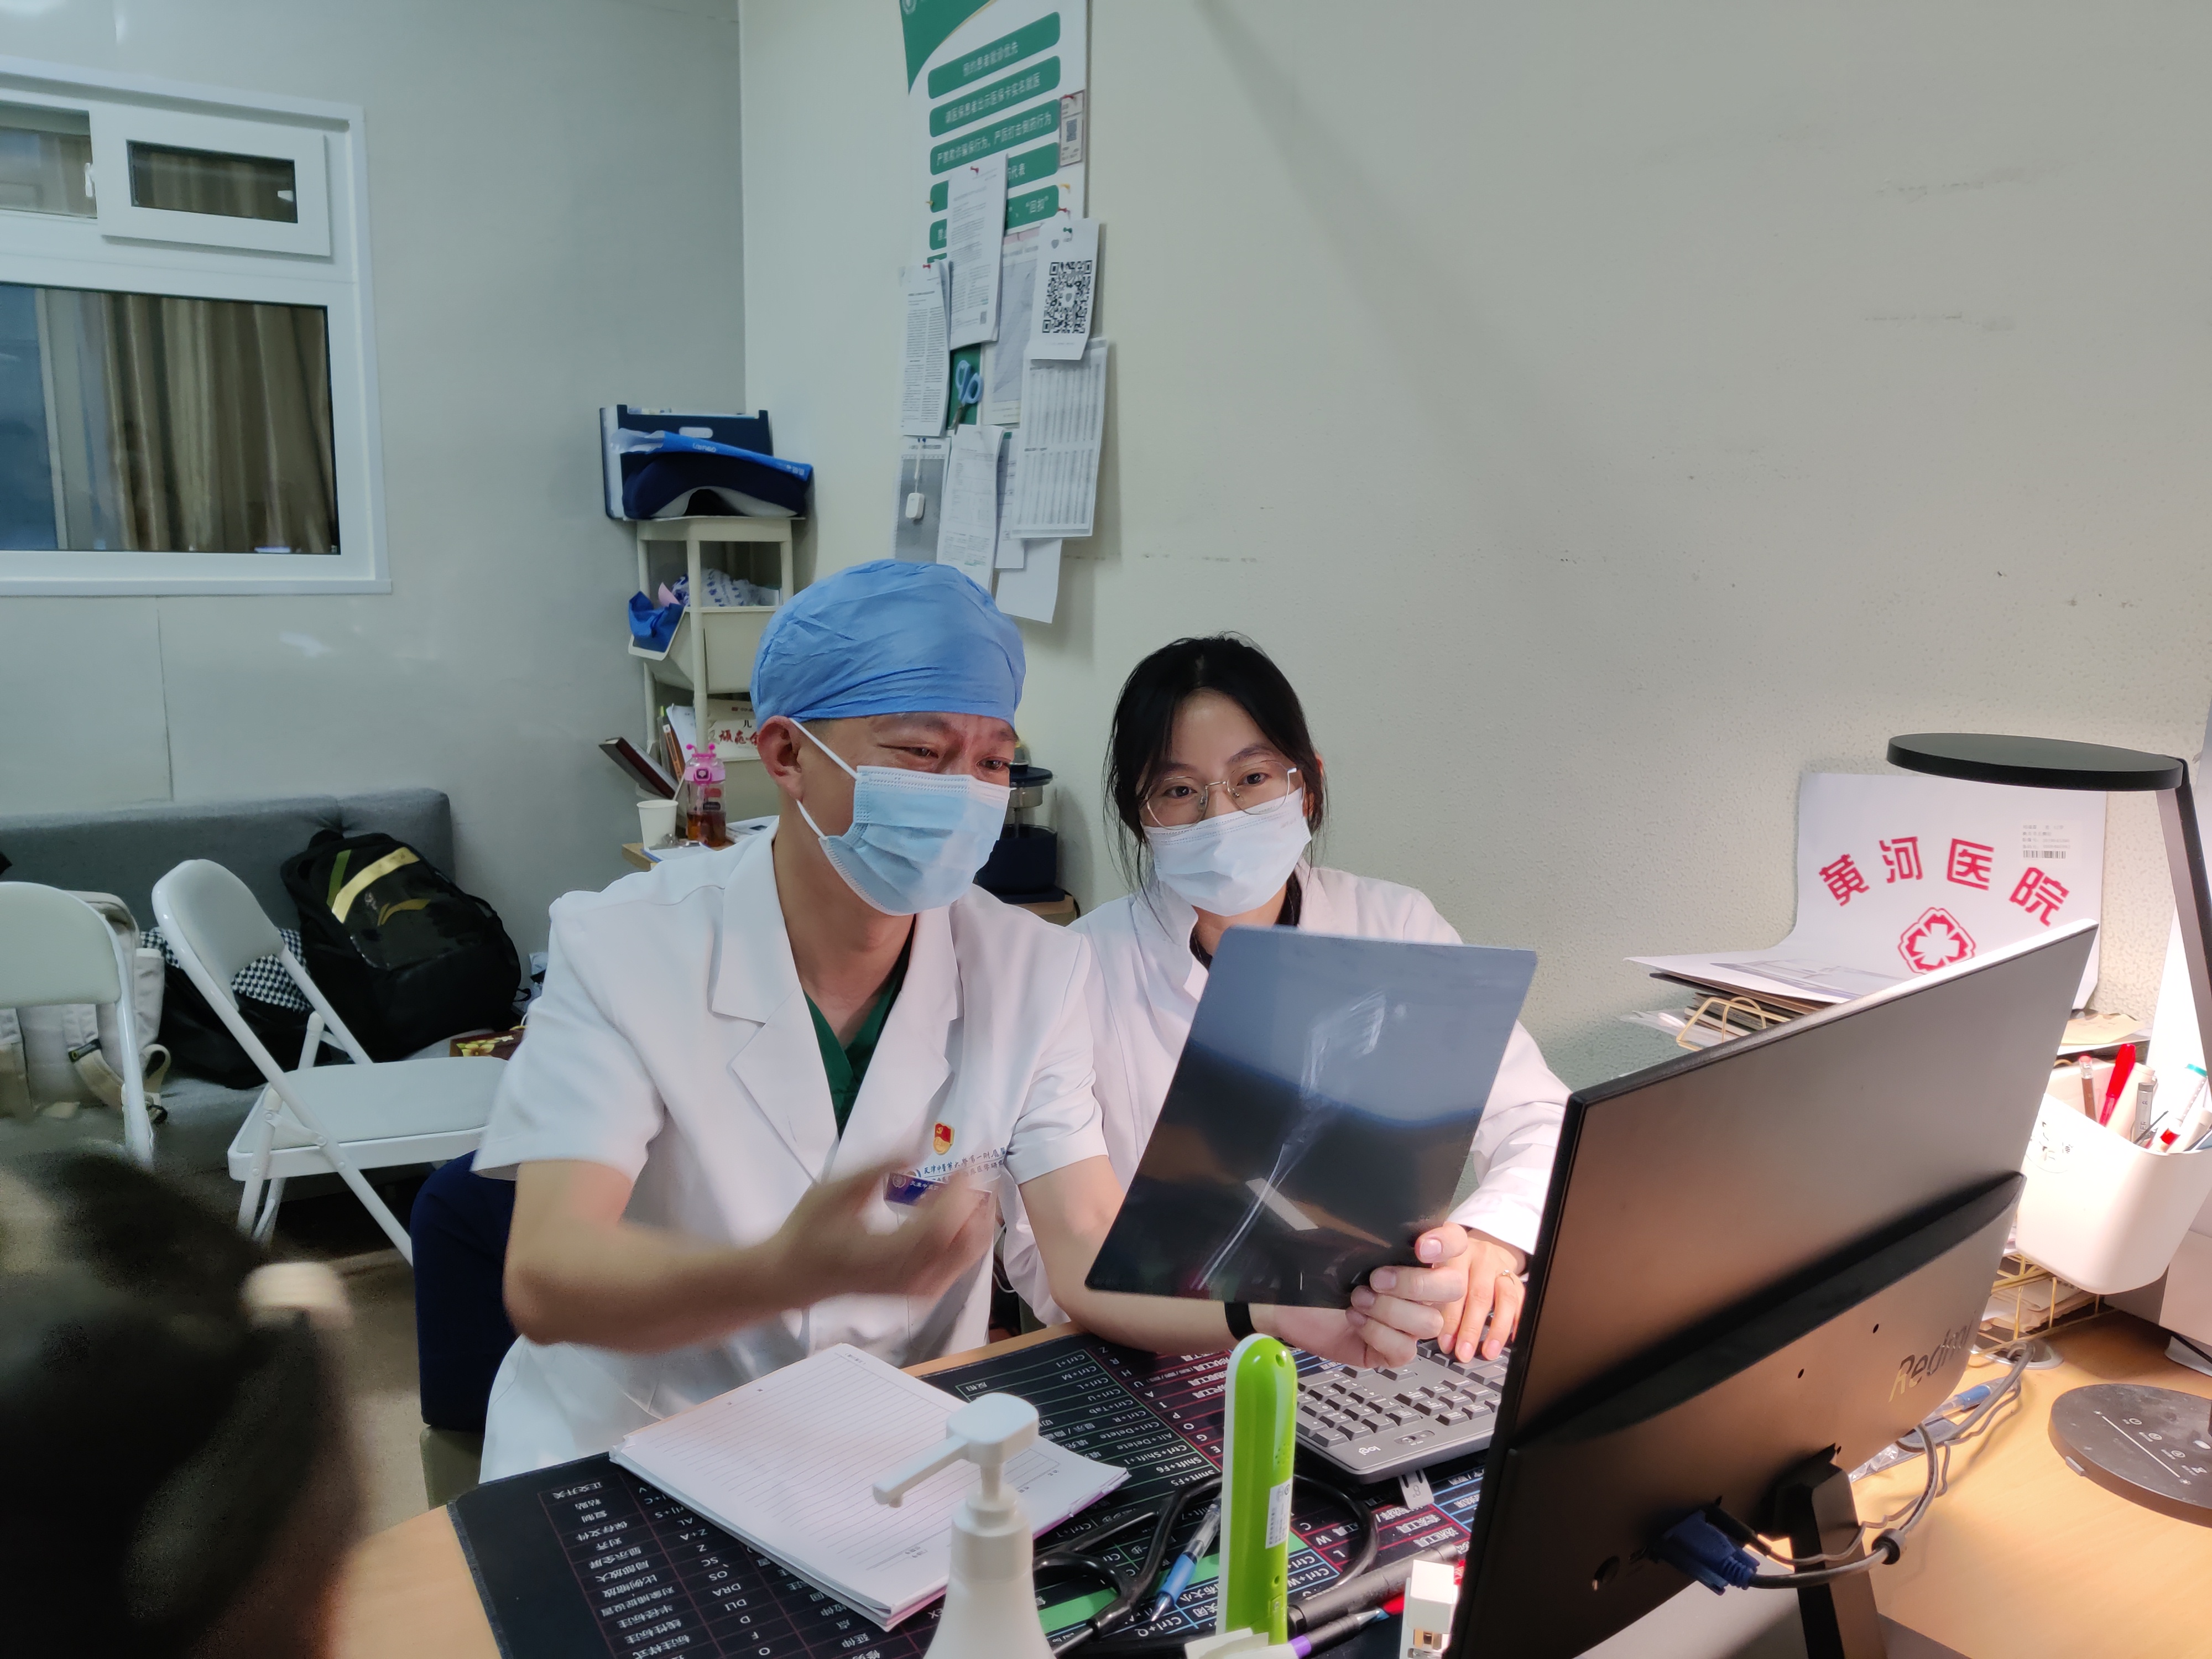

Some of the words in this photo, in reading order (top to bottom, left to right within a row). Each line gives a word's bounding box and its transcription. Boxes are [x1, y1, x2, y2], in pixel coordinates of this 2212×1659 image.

[1818, 836, 2069, 926] 黄河医院
[1888, 1310, 1976, 1402] Redmi
[1062, 1365, 1097, 1380] Ctrl+M
[1076, 1376, 1109, 1390] Ctrl+L
[1088, 1388, 1121, 1401] Ctrl+U
[1089, 1399, 1134, 1415] Ctrl+Tab
[1112, 1410, 1146, 1422] Ctrl+R
[1099, 1421, 1160, 1440] Ctrl+Delete
[1117, 1432, 1172, 1451] Alt+Delete
[1359, 1446, 1381, 1455] logi
[1156, 1457, 1202, 1472] Shift+F6
[1171, 1470, 1215, 1486] Shift+F5
[576, 1521, 627, 1541] 保存文件
[1300, 1522, 1311, 1530] C
[680, 1528, 707, 1540] Z+A
[1316, 1535, 1332, 1545] W
[589, 1546, 641, 1569] 显示全屏
[1333, 1550, 1345, 1558] L
[701, 1557, 718, 1567] SC
[1288, 1555, 1316, 1570] Ctrl+
[595, 1560, 649, 1583] 局部放大
[708, 1571, 728, 1580] OS
[1288, 1567, 1329, 1587] Ctrl+W
[602, 1574, 657, 1598] 比例缩放
[712, 1583, 741, 1597] DRA
[1180, 1584, 1219, 1601] 布大小
[724, 1599, 747, 1611] DLI
[617, 1605, 673, 1628] 半径标注
[740, 1615, 750, 1624] D
[624, 1619, 681, 1644] 线性标注
[1134, 1616, 1182, 1637] Ctrl+Q
[751, 1631, 759, 1640] F
[842, 1632, 870, 1647] 延伸
[633, 1635, 690, 1658] 标注样式
[759, 1647, 770, 1656] O
